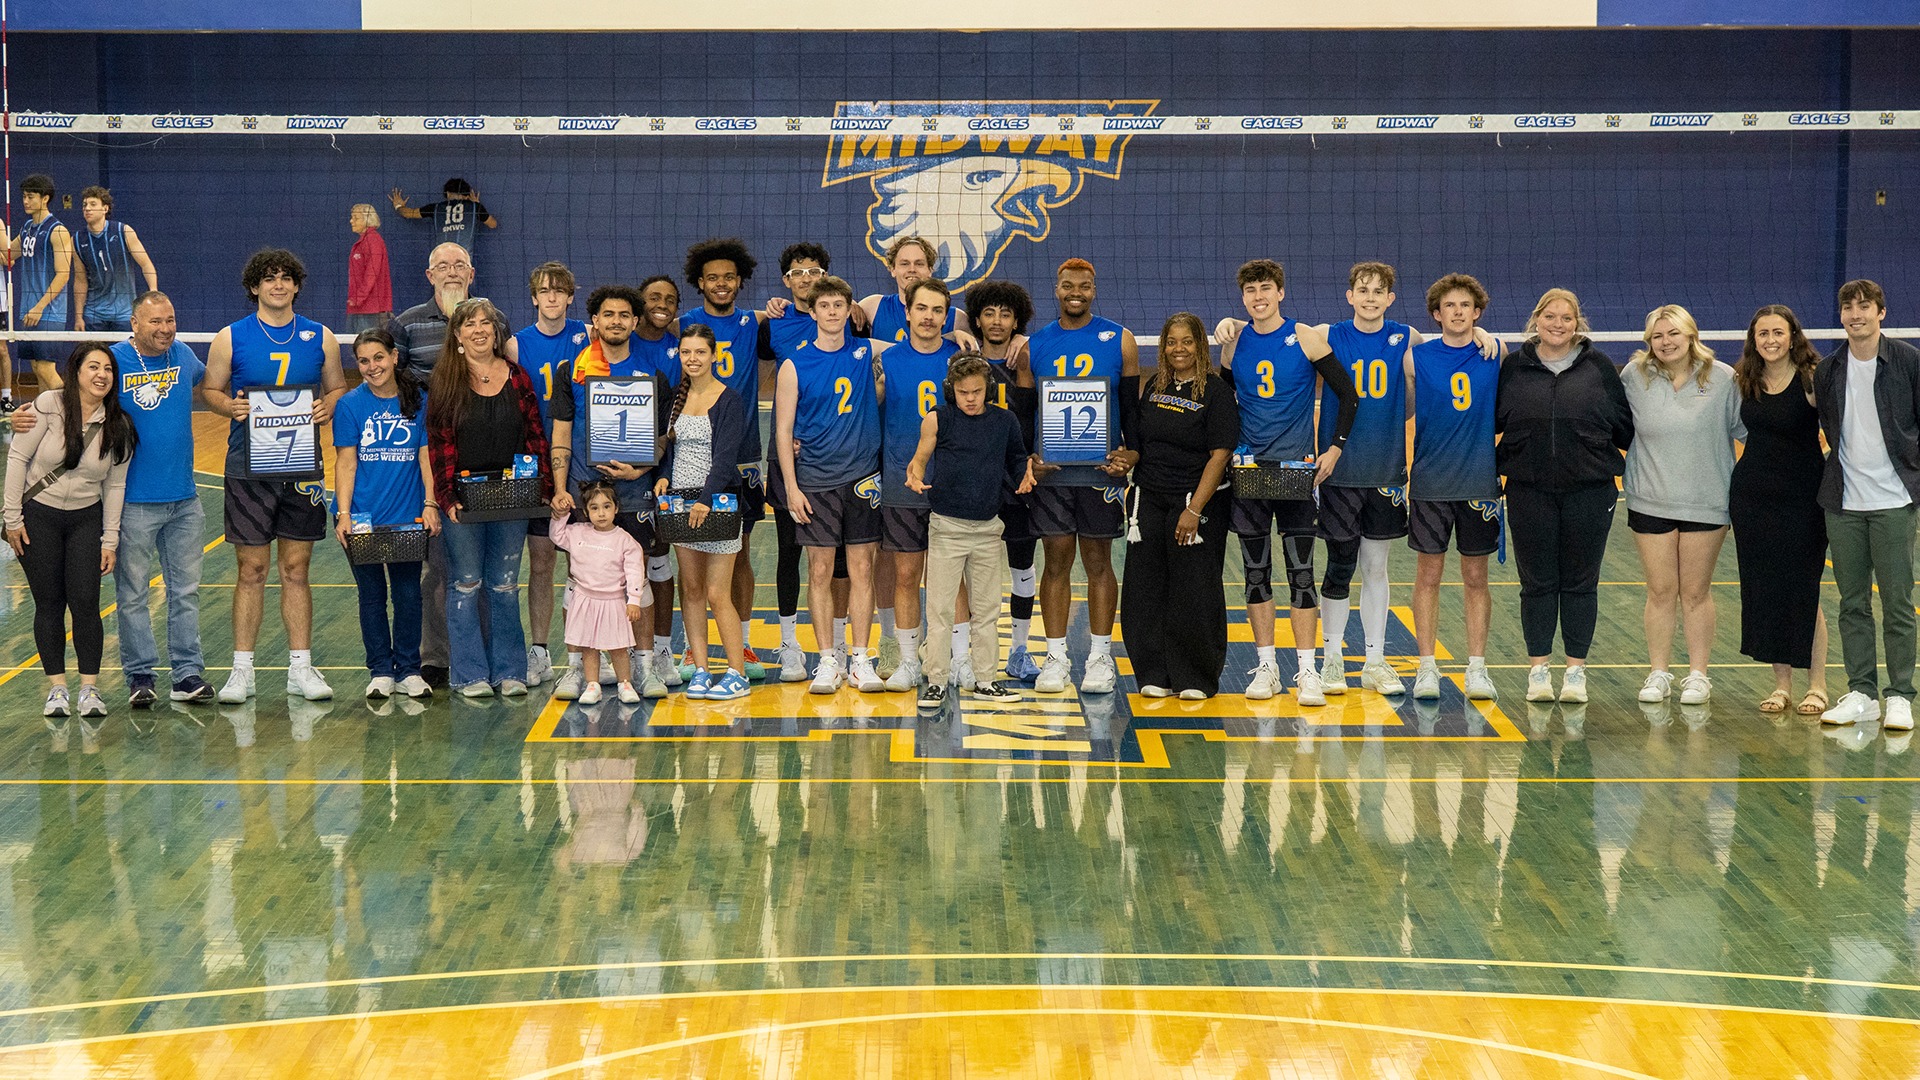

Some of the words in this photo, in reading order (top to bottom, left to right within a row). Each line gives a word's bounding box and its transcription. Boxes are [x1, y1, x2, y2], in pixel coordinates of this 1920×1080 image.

[16, 115, 77, 127] MIDWAY
[152, 117, 213, 128] EAGLES
[287, 118, 348, 129] MIDWAY
[424, 118, 484, 129] EAGLES
[559, 118, 620, 129] MIDWAY
[696, 118, 757, 130] EAGLES
[831, 119, 892, 130] MIDWAY
[968, 119, 1029, 130] EAGLES
[1103, 119, 1165, 130] MIDWAY
[1241, 118, 1303, 129] EAGLES
[1377, 117, 1438, 128] MIDWAY
[1515, 115, 1576, 127] EAGLES
[1650, 114, 1713, 126] MIDWAY
[1788, 113, 1850, 125] EAGLES
[445, 203, 464, 225] 18
[442, 224, 465, 233] SMWC
[22, 236, 36, 257] 99
[126, 368, 178, 387] MIDWAY
[270, 352, 290, 386] 7
[1053, 353, 1094, 377] 12
[1256, 360, 1276, 398] 3
[1351, 359, 1388, 399] 10
[1450, 372, 1472, 411] 9
[593, 394, 650, 406] MIDWAY
[834, 377, 853, 416] 2
[918, 380, 937, 418] 6
[1049, 391, 1106, 402] MIDWAY
[255, 414, 312, 427] MIDWAY
[376, 419, 411, 445] 175
[611, 409, 633, 442] 1
[1058, 405, 1098, 440] 12
[275, 430, 297, 464] 7
[359, 453, 379, 461] 2022
